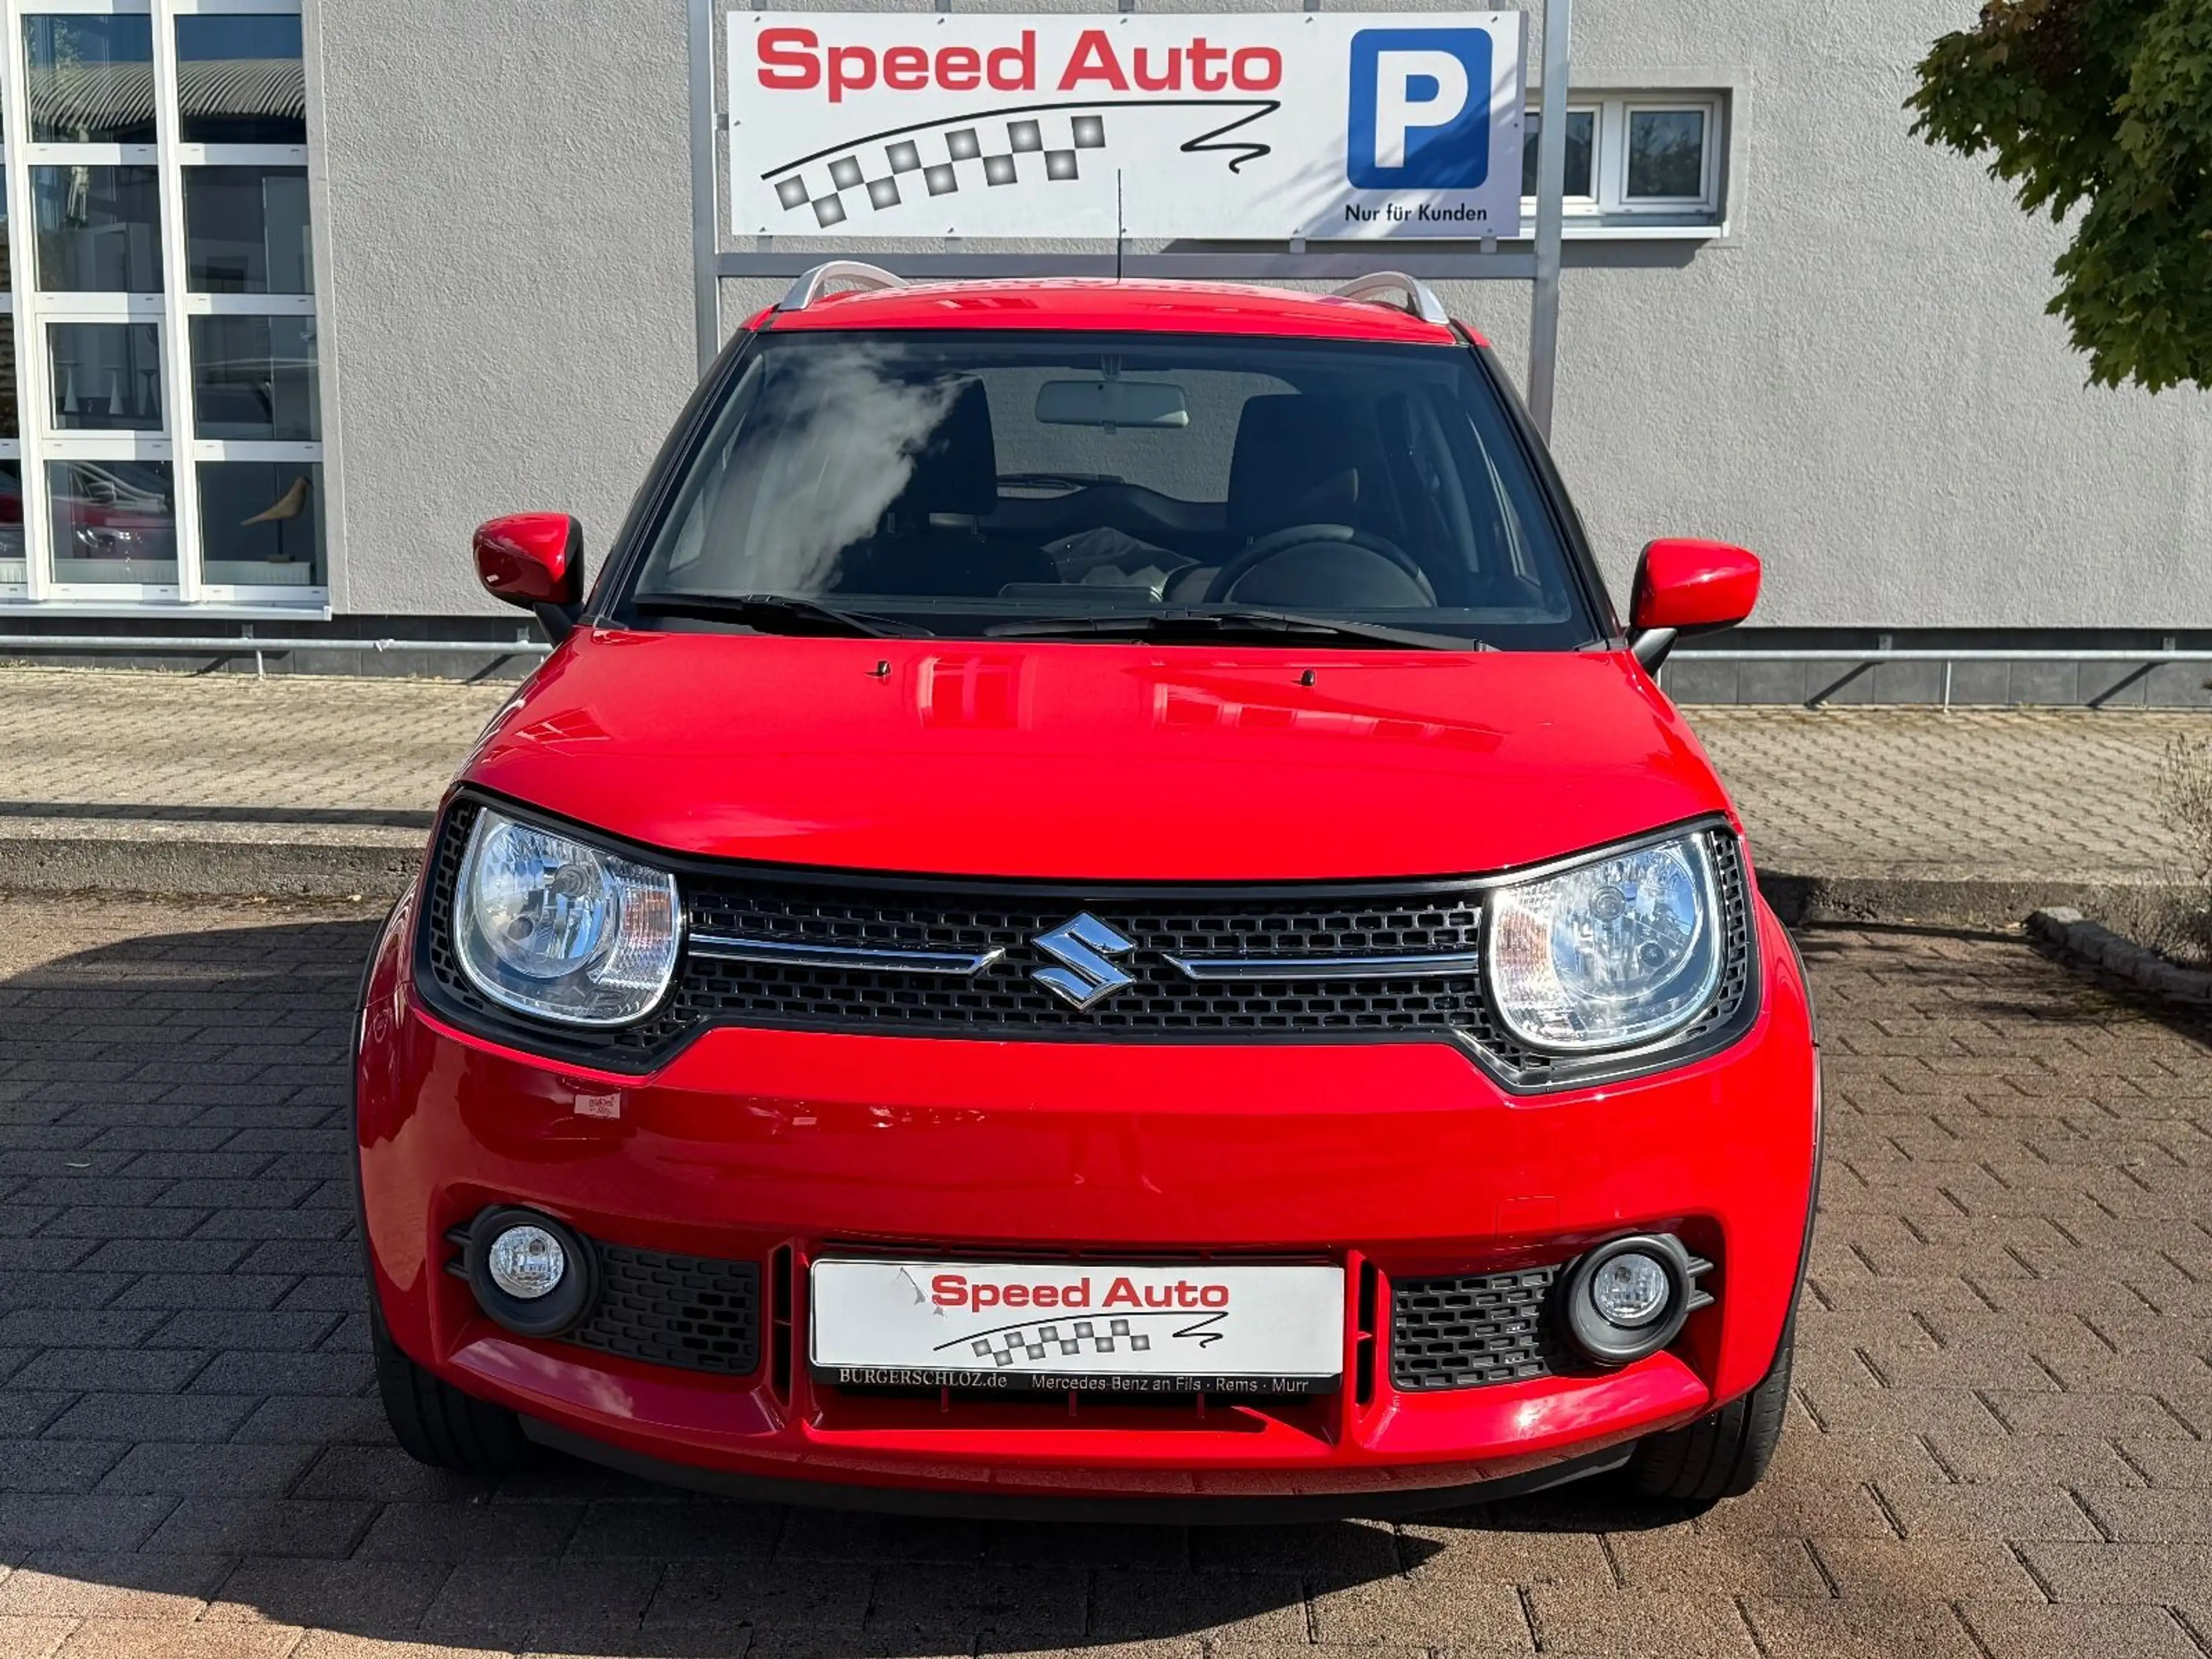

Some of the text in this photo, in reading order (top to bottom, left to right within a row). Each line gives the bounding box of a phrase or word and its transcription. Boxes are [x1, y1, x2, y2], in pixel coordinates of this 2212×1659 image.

[757, 28, 1282, 103] Speed Auto
[1375, 50, 1469, 168] P
[1345, 202, 1487, 222] Nur für Kunden
[931, 1274, 1230, 1312] Speed Auto
[1153, 1380, 1171, 1391] an
[1176, 1377, 1201, 1391] Fils
[1216, 1377, 1258, 1392] Rems
[1272, 1378, 1309, 1392] Murr
